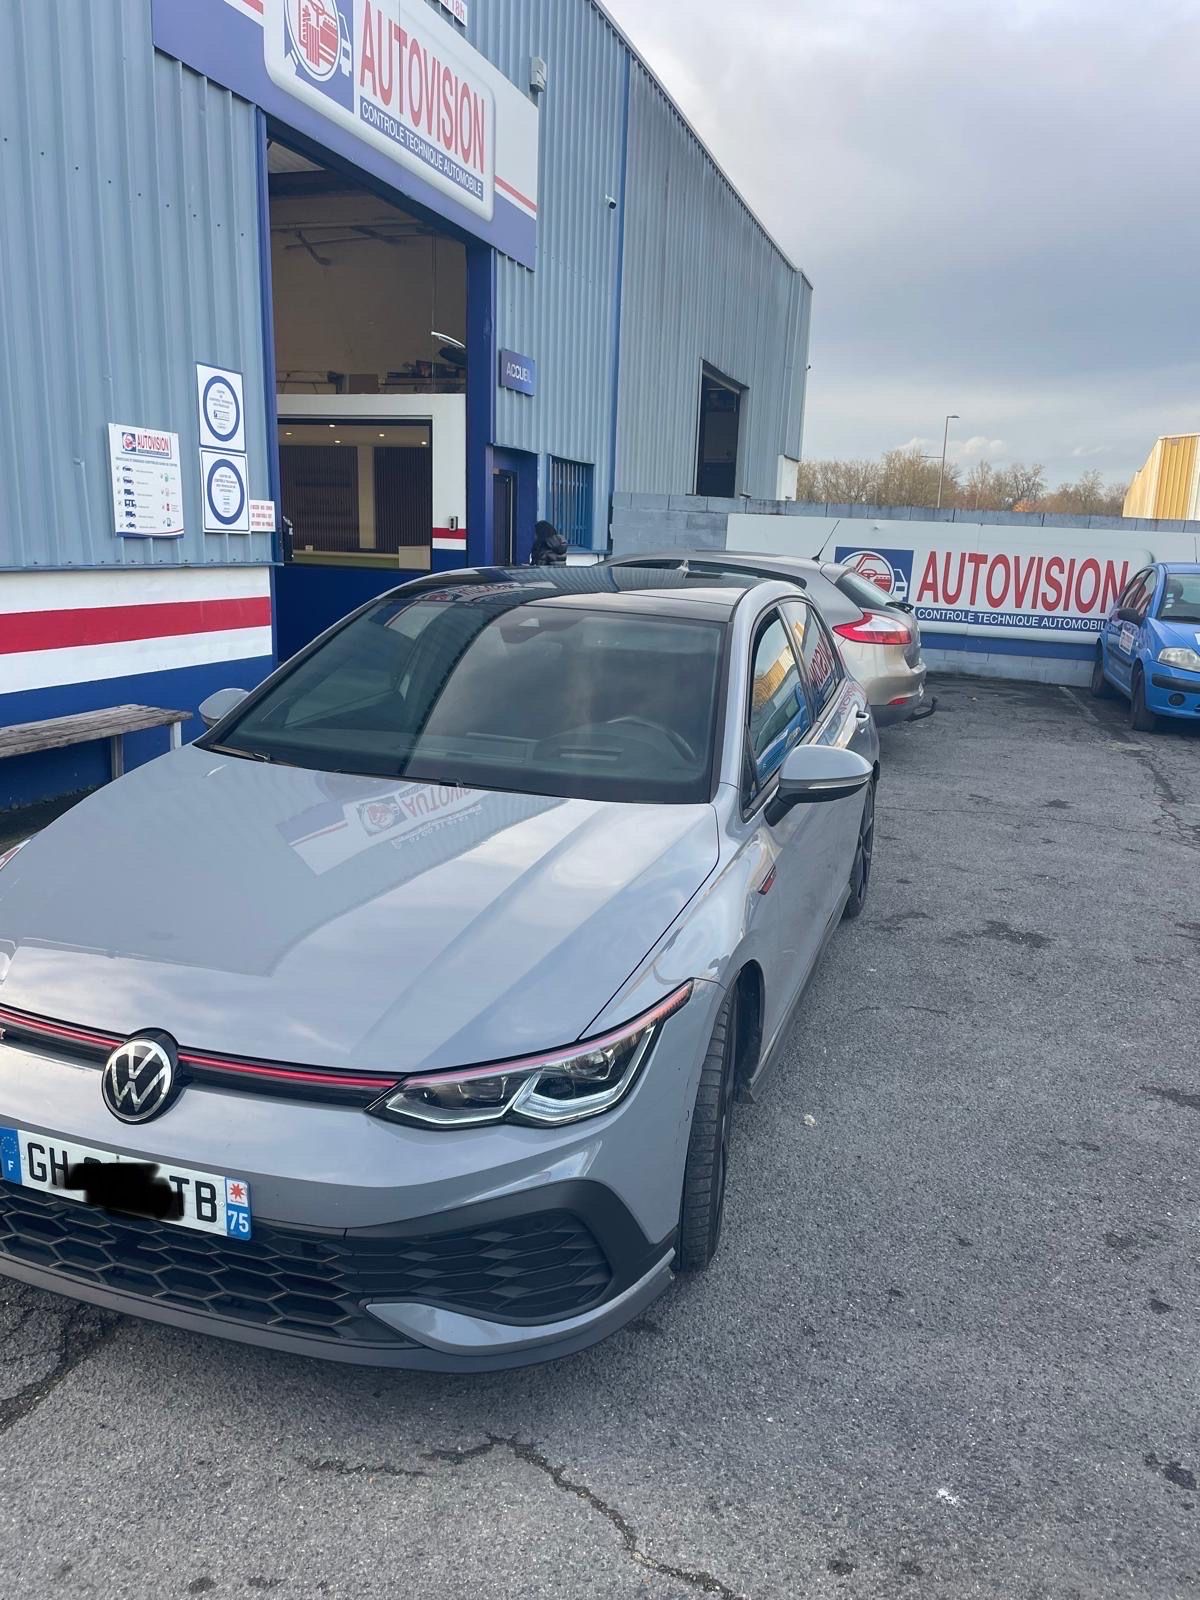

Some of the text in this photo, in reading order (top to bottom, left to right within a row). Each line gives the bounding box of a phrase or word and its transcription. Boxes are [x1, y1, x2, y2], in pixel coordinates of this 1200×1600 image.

[359, 0, 484, 174] AUTOVISION
[361, 101, 482, 197] CONTROLE TECHNIQUE AUTOMOBILE
[916, 550, 1129, 614] AUTOVISION
[917, 608, 1107, 630] CONTROLE TECHNIQUE AUTOMOBIL
[8, 1160, 14, 1172] F
[227, 1210, 249, 1233] 75
